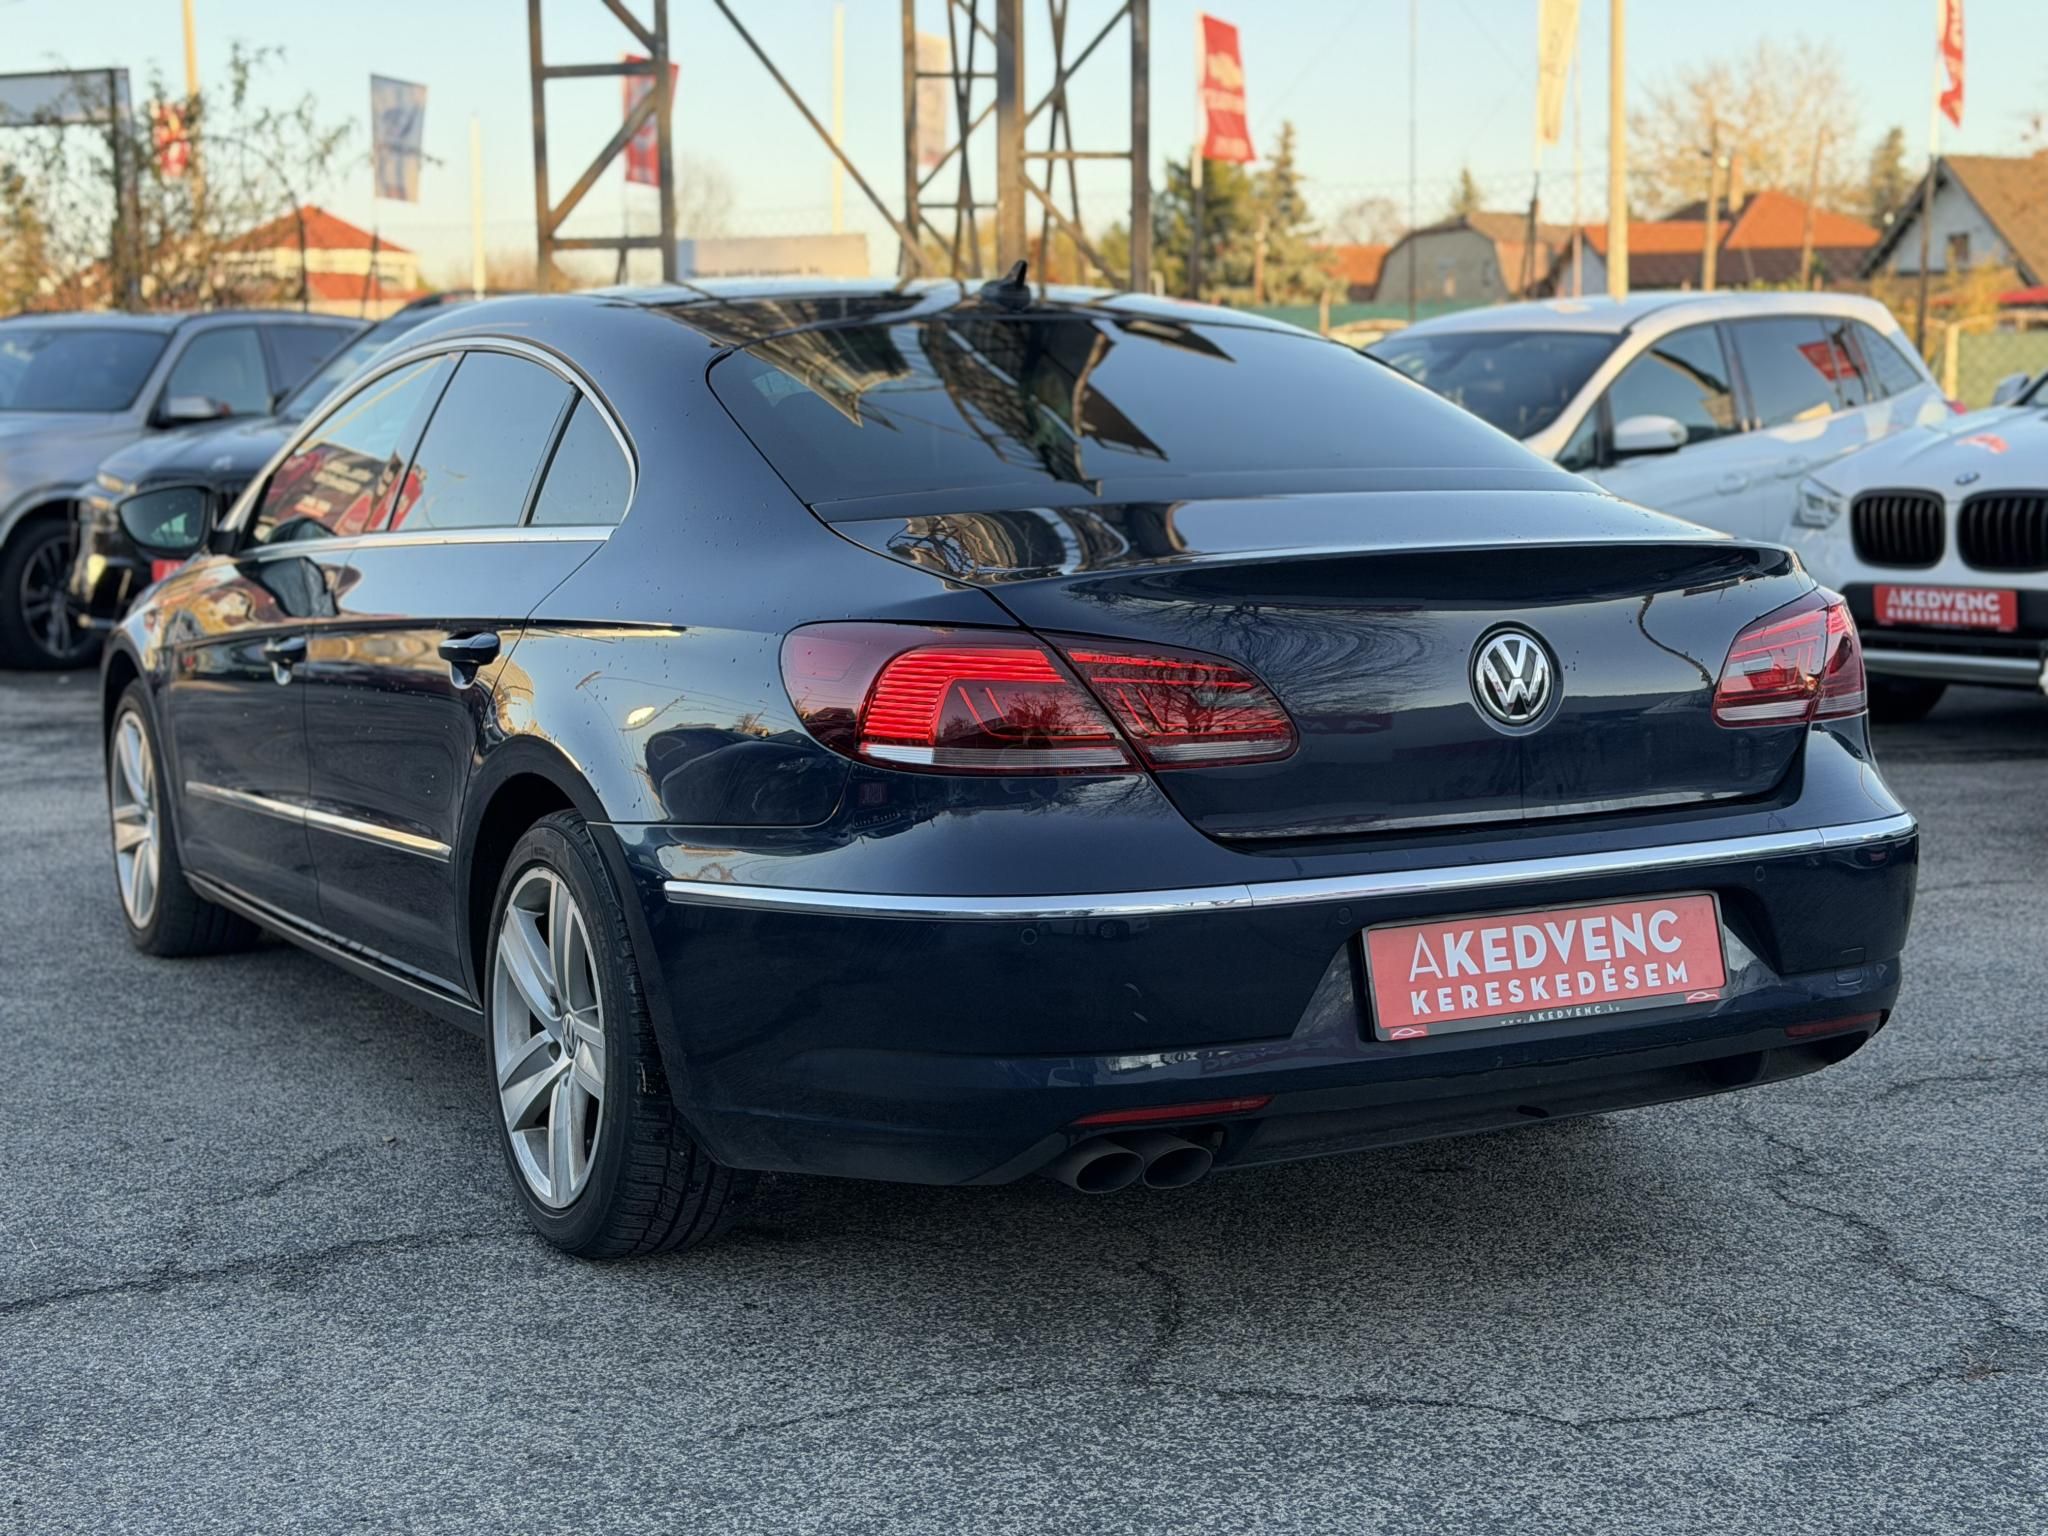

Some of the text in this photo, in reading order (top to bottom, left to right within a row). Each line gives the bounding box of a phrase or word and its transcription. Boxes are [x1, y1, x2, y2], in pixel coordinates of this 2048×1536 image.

[1887, 589, 2000, 612] AKEDVENC
[1409, 910, 1683, 982] AKEDVENC
[1411, 960, 1689, 1015] KERESKEDÉSEM
